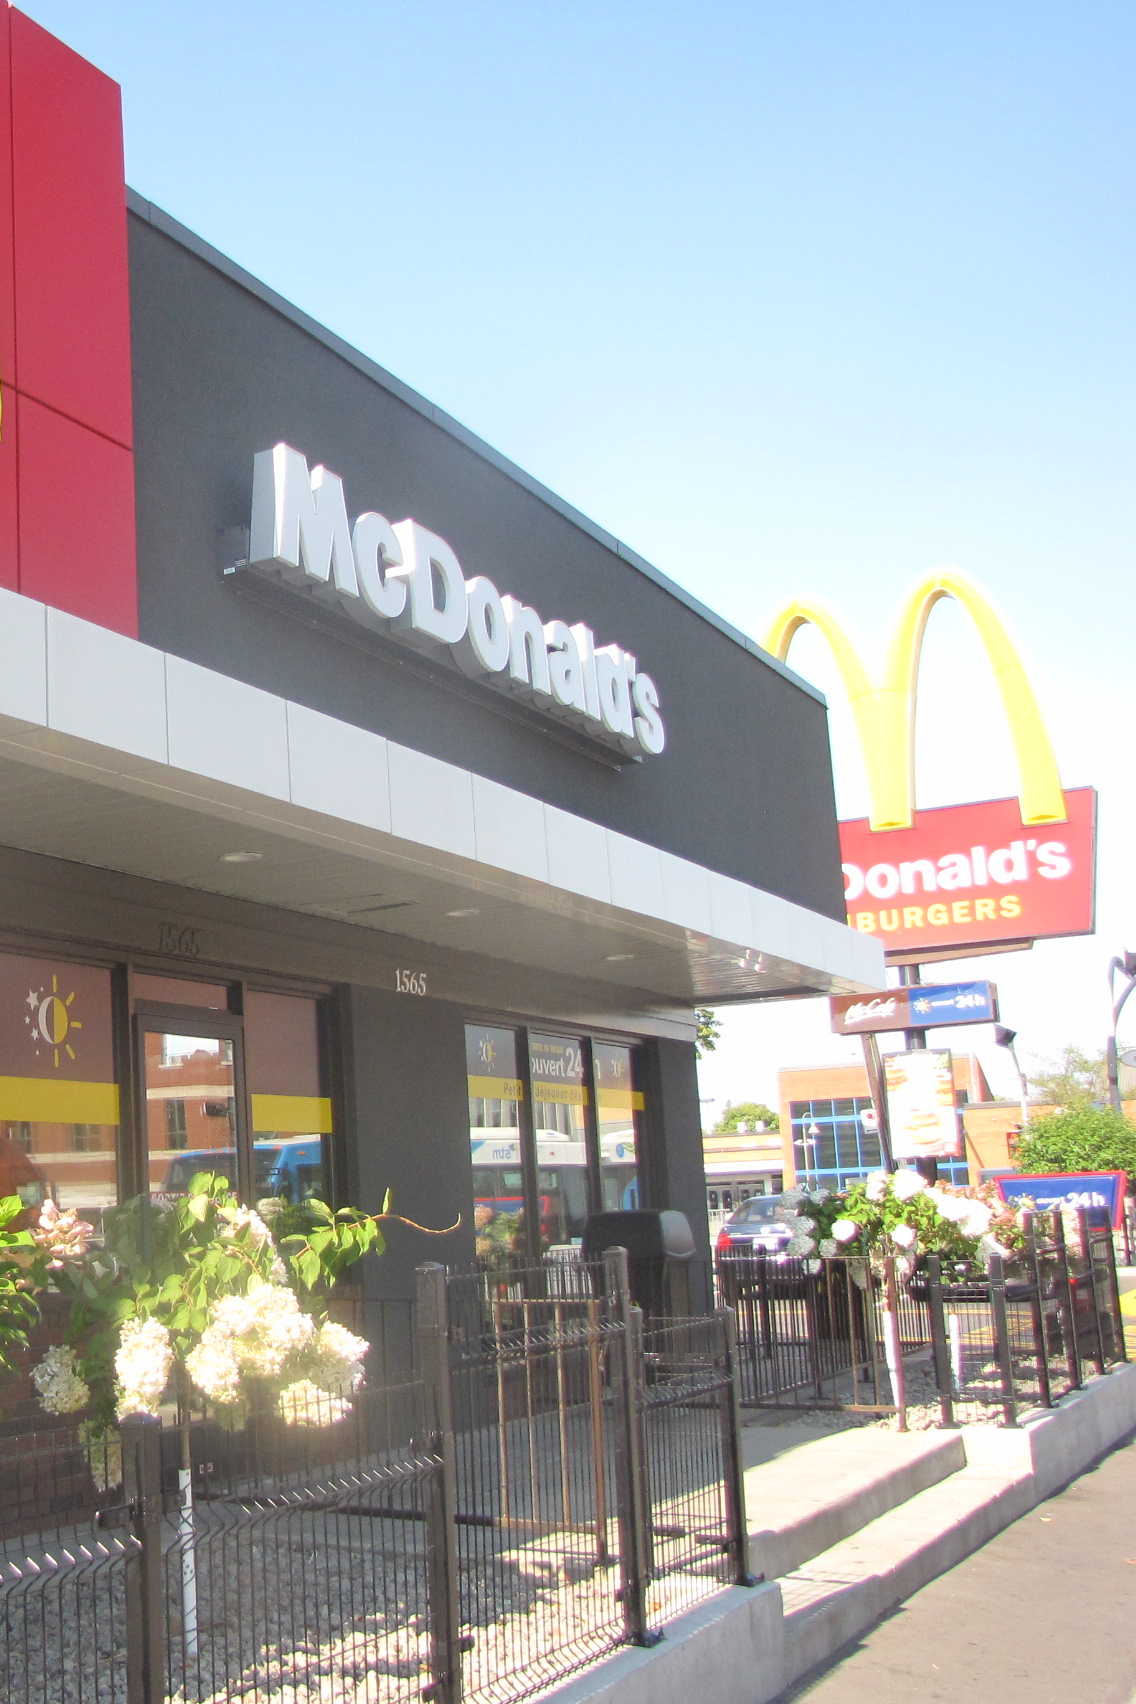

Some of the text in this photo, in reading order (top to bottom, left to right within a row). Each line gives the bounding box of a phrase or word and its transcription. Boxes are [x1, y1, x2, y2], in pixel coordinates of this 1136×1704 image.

[250, 443, 665, 754] McDonald's
[847, 896, 1022, 933] BURGERS
[395, 968, 427, 996] 1565
